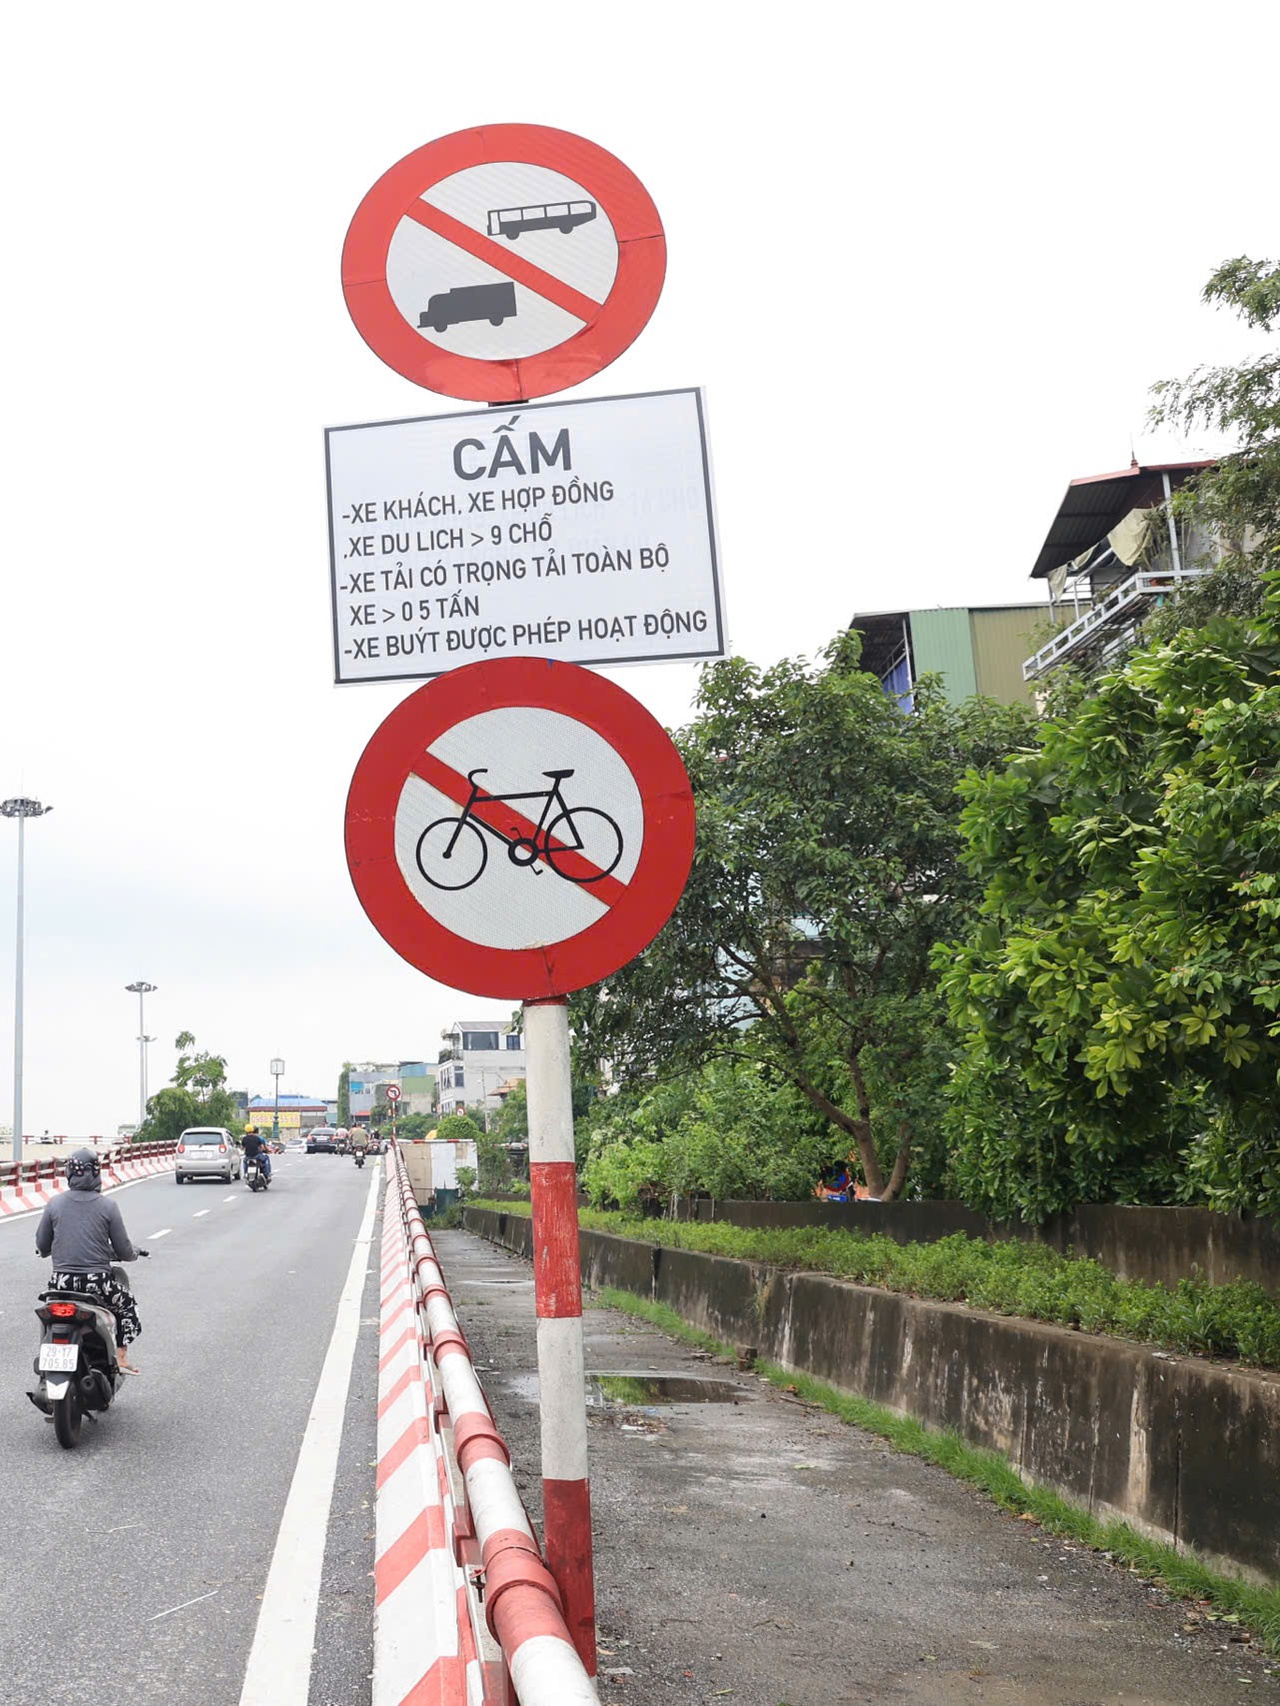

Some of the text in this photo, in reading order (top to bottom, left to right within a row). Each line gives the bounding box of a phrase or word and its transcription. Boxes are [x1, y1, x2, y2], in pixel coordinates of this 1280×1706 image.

[453, 415, 572, 481] CẤM
[468, 491, 495, 513] XE
[502, 487, 545, 512] HỢP
[552, 476, 613, 505] ĐỒNG
[382, 533, 409, 554] DU
[417, 528, 463, 551] LICH
[491, 525, 501, 545] 9
[509, 513, 552, 544] CHỖ
[380, 562, 413, 590] TẢI
[420, 560, 447, 587] CÓ
[453, 558, 526, 586] TRỌNG
[532, 548, 565, 577] TẢI
[572, 545, 631, 574] TOÀN
[640, 543, 669, 572] BỘ
[350, 604, 376, 626] XE
[436, 589, 479, 619] TẤN
[386, 627, 440, 656] BUÝT
[446, 625, 506, 653] ĐƯỢC
[513, 621, 571, 646] PHÉP
[578, 616, 637, 642] HOẠT
[643, 609, 707, 635] ĐỘNG
